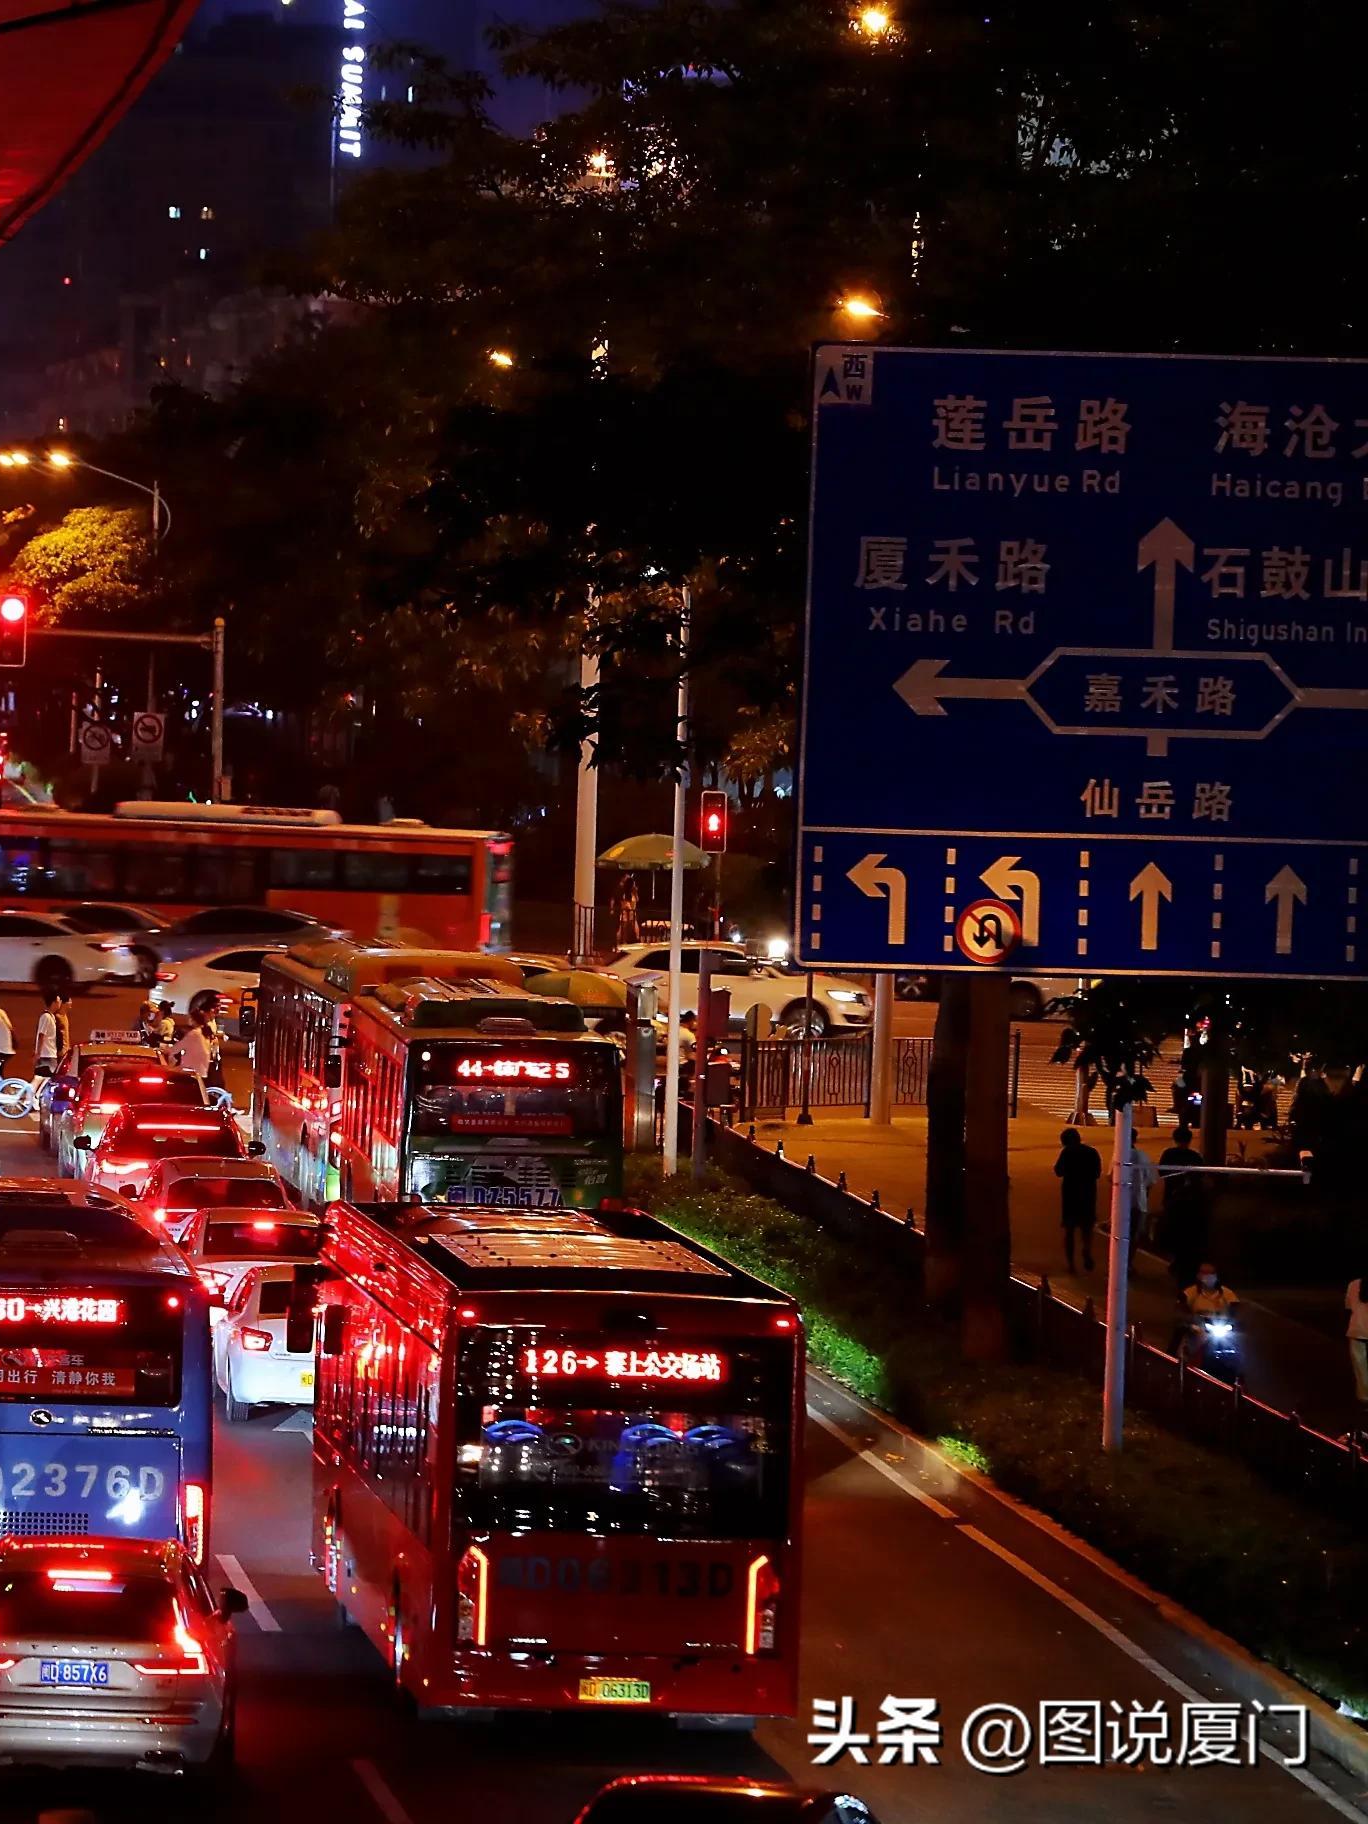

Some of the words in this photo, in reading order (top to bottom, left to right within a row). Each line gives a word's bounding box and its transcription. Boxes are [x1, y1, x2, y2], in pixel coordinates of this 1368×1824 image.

[339, 46, 365, 158] SUMMIT
[841, 353, 869, 379] 西
[845, 384, 865, 401] W
[932, 396, 1131, 453] 莲岳路
[933, 467, 1070, 497] Lianyue
[1083, 469, 1121, 495] Rd
[1211, 472, 1343, 507] Haicang
[855, 536, 1051, 594] 厦禾路
[1201, 546, 1368, 601] 石鼓山
[868, 606, 968, 633] Xiahe
[995, 610, 1035, 636] Rd
[1206, 618, 1334, 647] Shigushan
[1084, 672, 1237, 717] 嘉禾路
[1080, 778, 1233, 822] 仙岳路
[51, 1370, 116, 1386] 清静你我
[523, 1349, 578, 1375] 126
